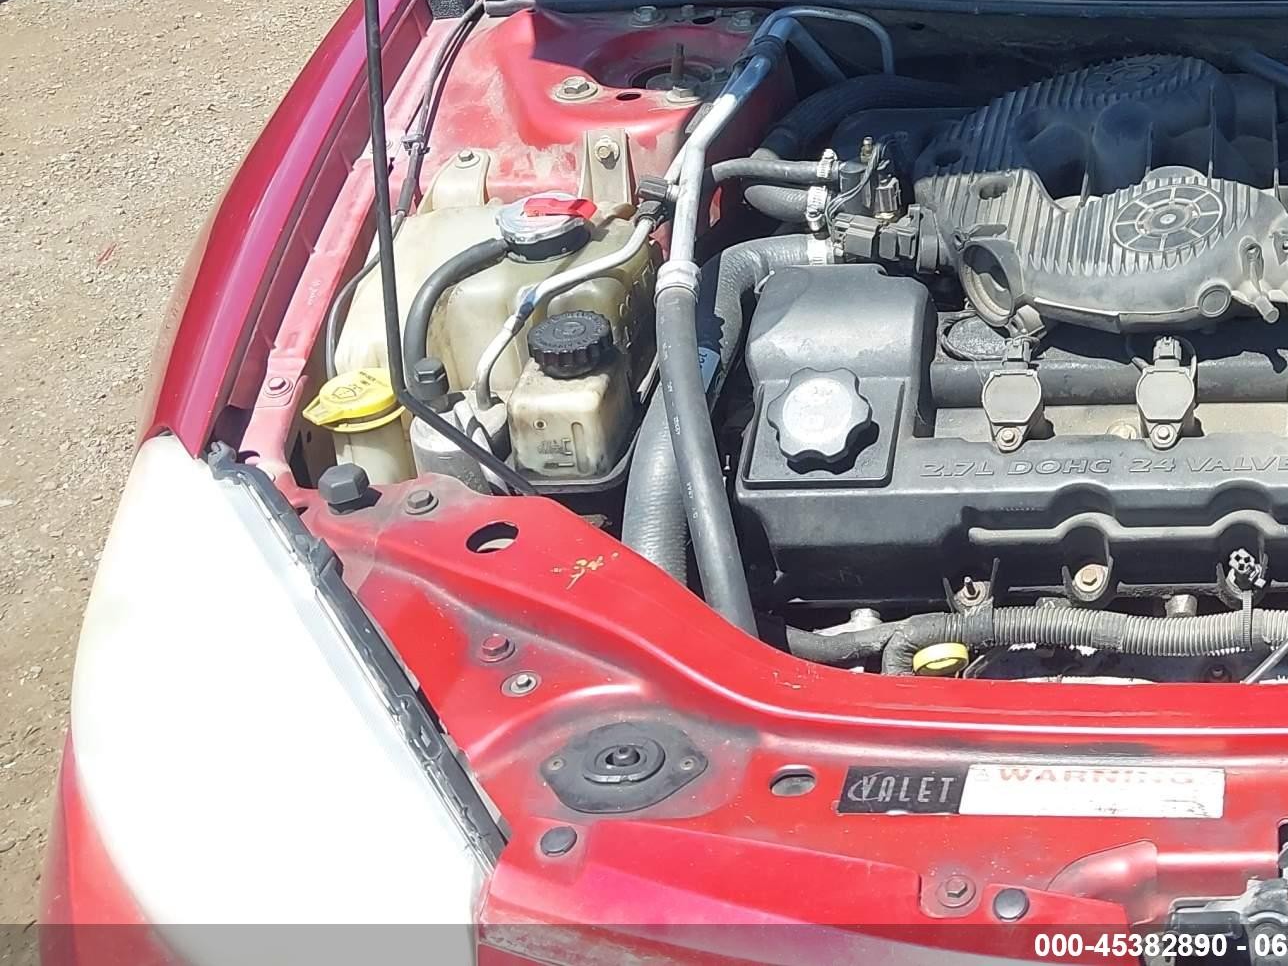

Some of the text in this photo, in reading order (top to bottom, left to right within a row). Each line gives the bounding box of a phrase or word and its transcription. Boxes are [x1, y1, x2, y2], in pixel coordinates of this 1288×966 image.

[919, 461, 994, 477] 2.7L
[1007, 459, 1112, 475] DOHC
[1128, 457, 1176, 472] 24
[848, 772, 956, 804] VALET
